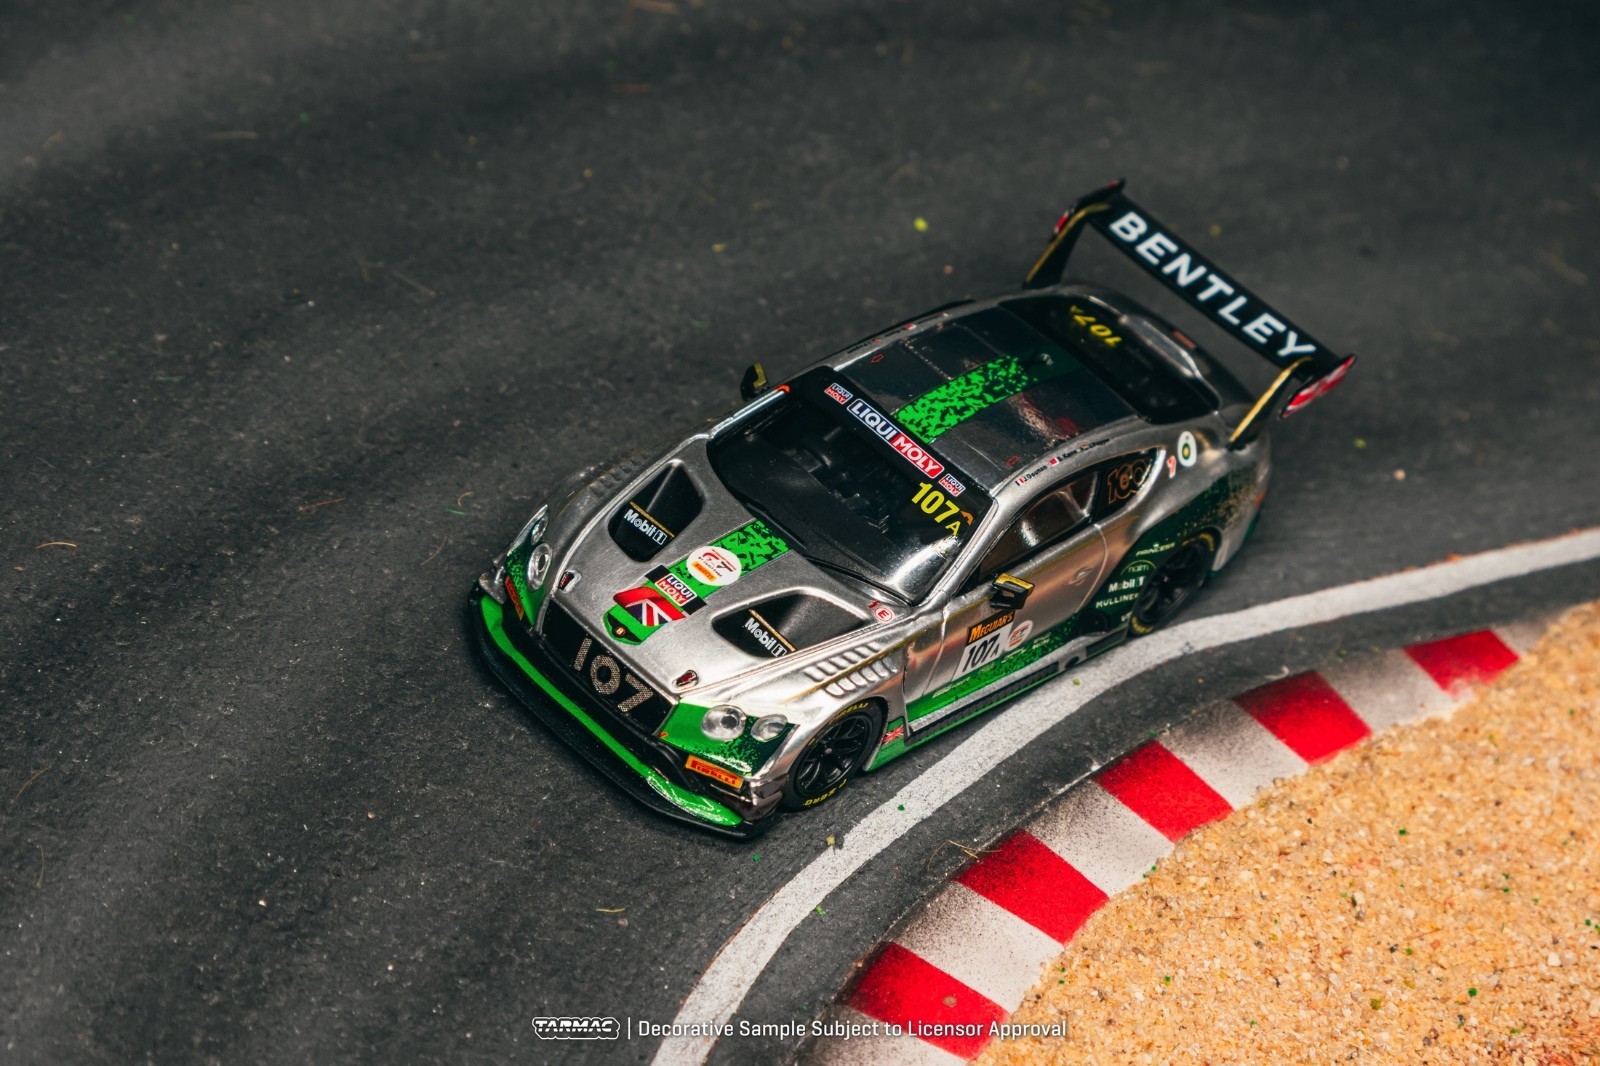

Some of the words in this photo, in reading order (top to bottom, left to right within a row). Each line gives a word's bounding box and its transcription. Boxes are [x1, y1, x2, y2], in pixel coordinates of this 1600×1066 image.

[1108, 211, 1316, 357] BENTLEY
[826, 389, 845, 404] MOLY
[833, 384, 850, 398] LIQUI
[851, 402, 898, 440] LIQUI
[893, 436, 939, 472] MOLY
[940, 479, 960, 495] MOLY
[946, 475, 964, 490] LIQUI
[624, 509, 657, 537] Mobil
[658, 581, 686, 605] MOLY
[666, 576, 693, 598] LIQUI
[744, 618, 776, 650] Mobil
[574, 638, 653, 712] 107
[691, 760, 737, 785] PIRELLI
